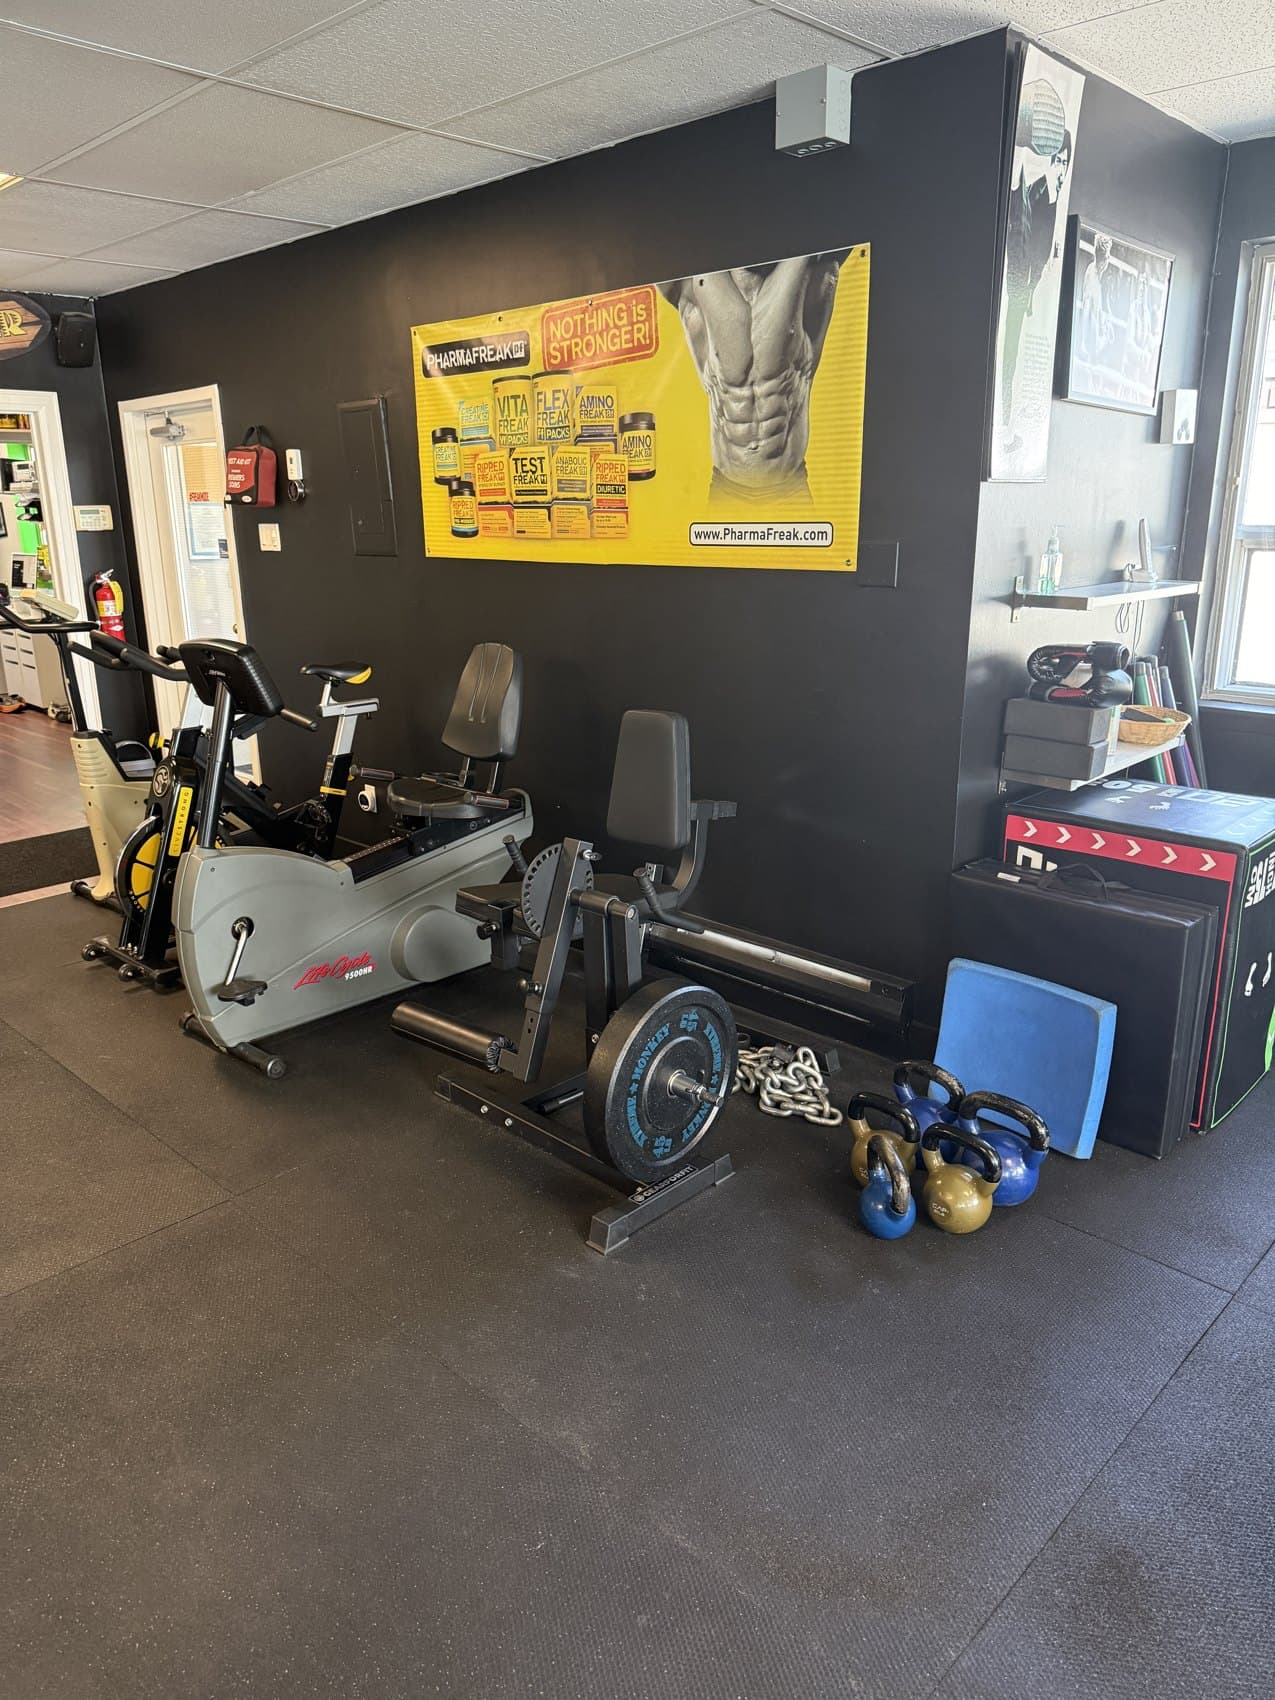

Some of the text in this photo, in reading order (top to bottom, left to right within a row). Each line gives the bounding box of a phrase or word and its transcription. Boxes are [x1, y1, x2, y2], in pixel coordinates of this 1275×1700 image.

[550, 299, 647, 341] NOTHING is
[550, 322, 650, 364] STRONGER!
[426, 341, 514, 370] PHARMAFREAK
[497, 394, 529, 418] VITA
[536, 389, 569, 411] FLEX
[580, 395, 614, 409] AMINO
[536, 410, 569, 427] FREAK
[580, 409, 604, 420] FREAK
[498, 417, 529, 432] FREAK
[508, 433, 529, 446] PACKS
[546, 427, 570, 440] PACKS
[622, 434, 652, 449] AMINO
[477, 461, 504, 473] RIPPED
[512, 456, 545, 475] TEST
[556, 456, 587, 466] ANABOLIC
[596, 462, 625, 474] RIPPED
[478, 473, 499, 483] FREAK
[556, 466, 580, 476] FREAK
[513, 474, 540, 486] FREAK
[596, 474, 619, 484] FREAK
[597, 484, 626, 494] DIURETIC
[694, 527, 829, 541] www.PharmaFreak.com
[1244, 865, 1259, 908] CM
[344, 965, 373, 981] 9500HR
[631, 1022, 670, 1081] MONKEY
